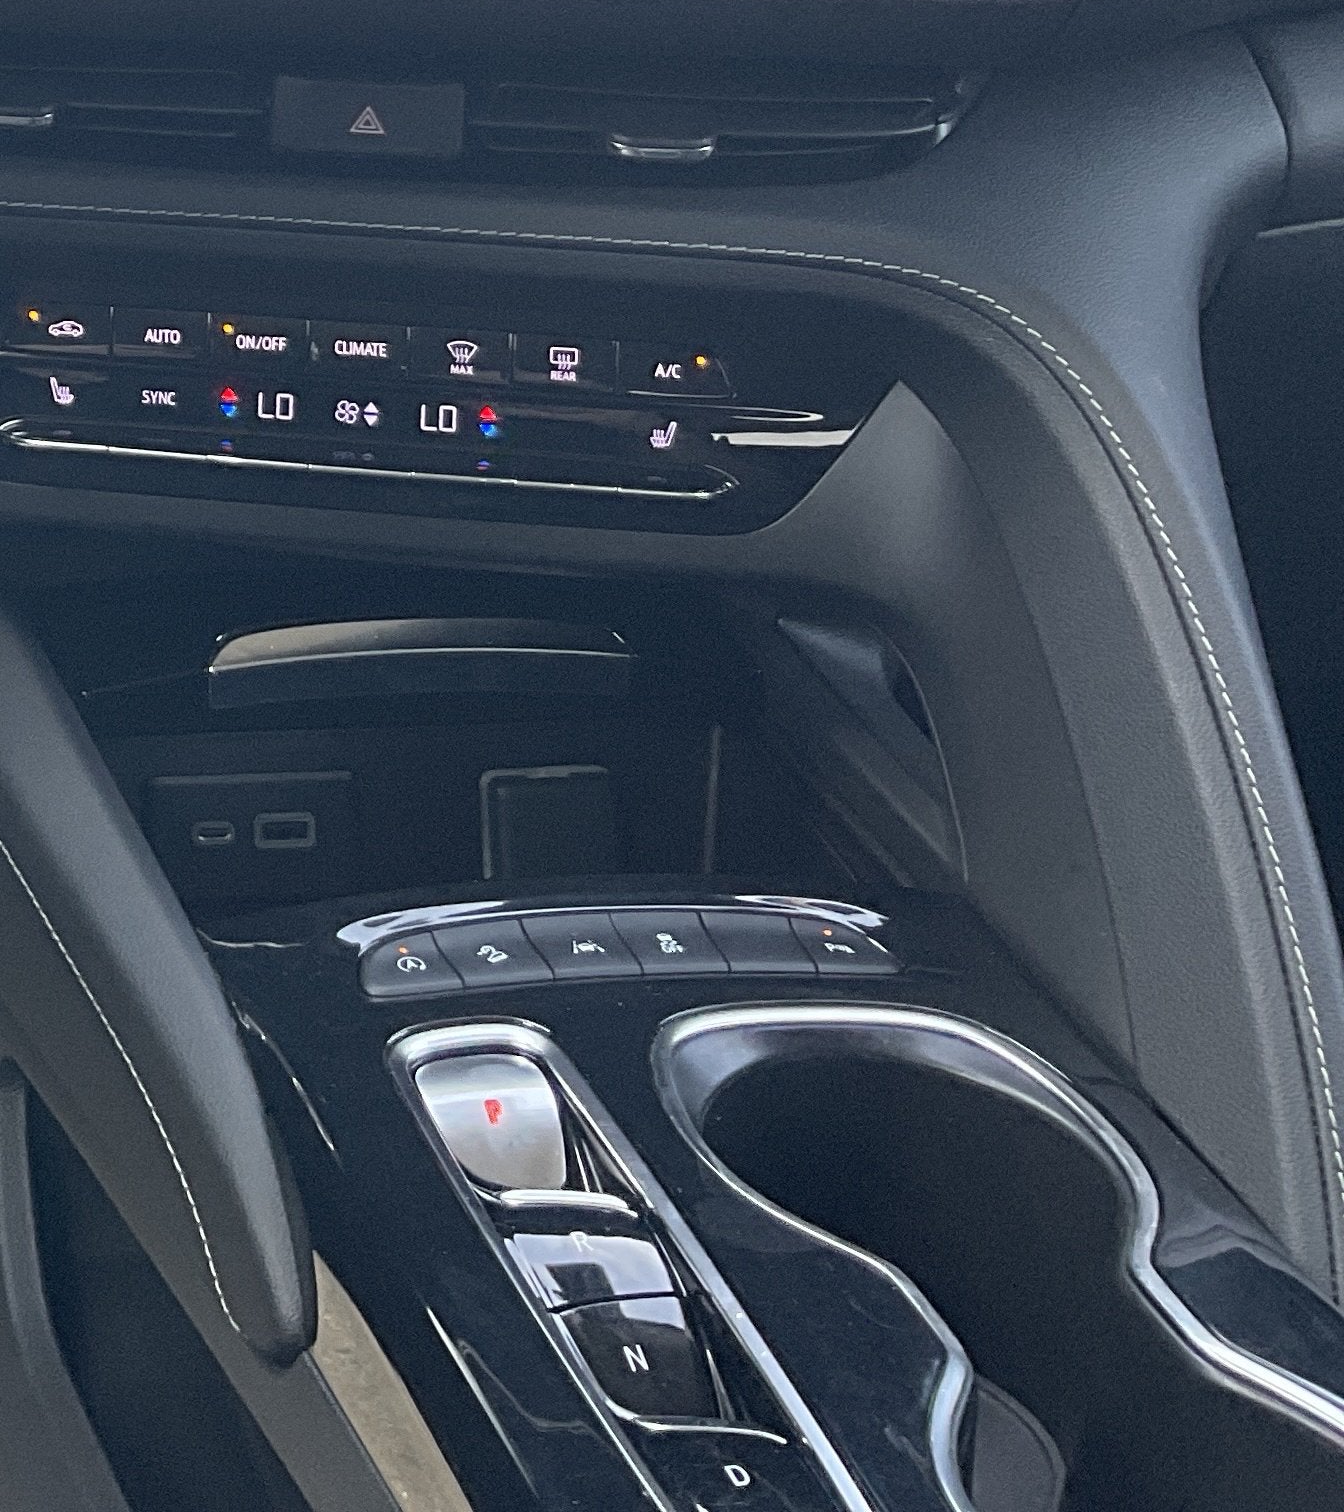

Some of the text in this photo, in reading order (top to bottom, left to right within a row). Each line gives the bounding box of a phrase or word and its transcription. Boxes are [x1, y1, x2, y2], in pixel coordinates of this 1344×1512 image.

[144, 328, 181, 345] AUTO
[235, 334, 287, 352] ON/OFF
[334, 339, 388, 358] CLIMATE
[449, 364, 474, 376] MAX
[550, 370, 577, 382] REAR
[654, 363, 682, 379] A/C
[141, 389, 176, 406] SYNC
[483, 1098, 503, 1125] P
[569, 1230, 594, 1253] R
[622, 1344, 650, 1372] N
[724, 1463, 752, 1487] D
